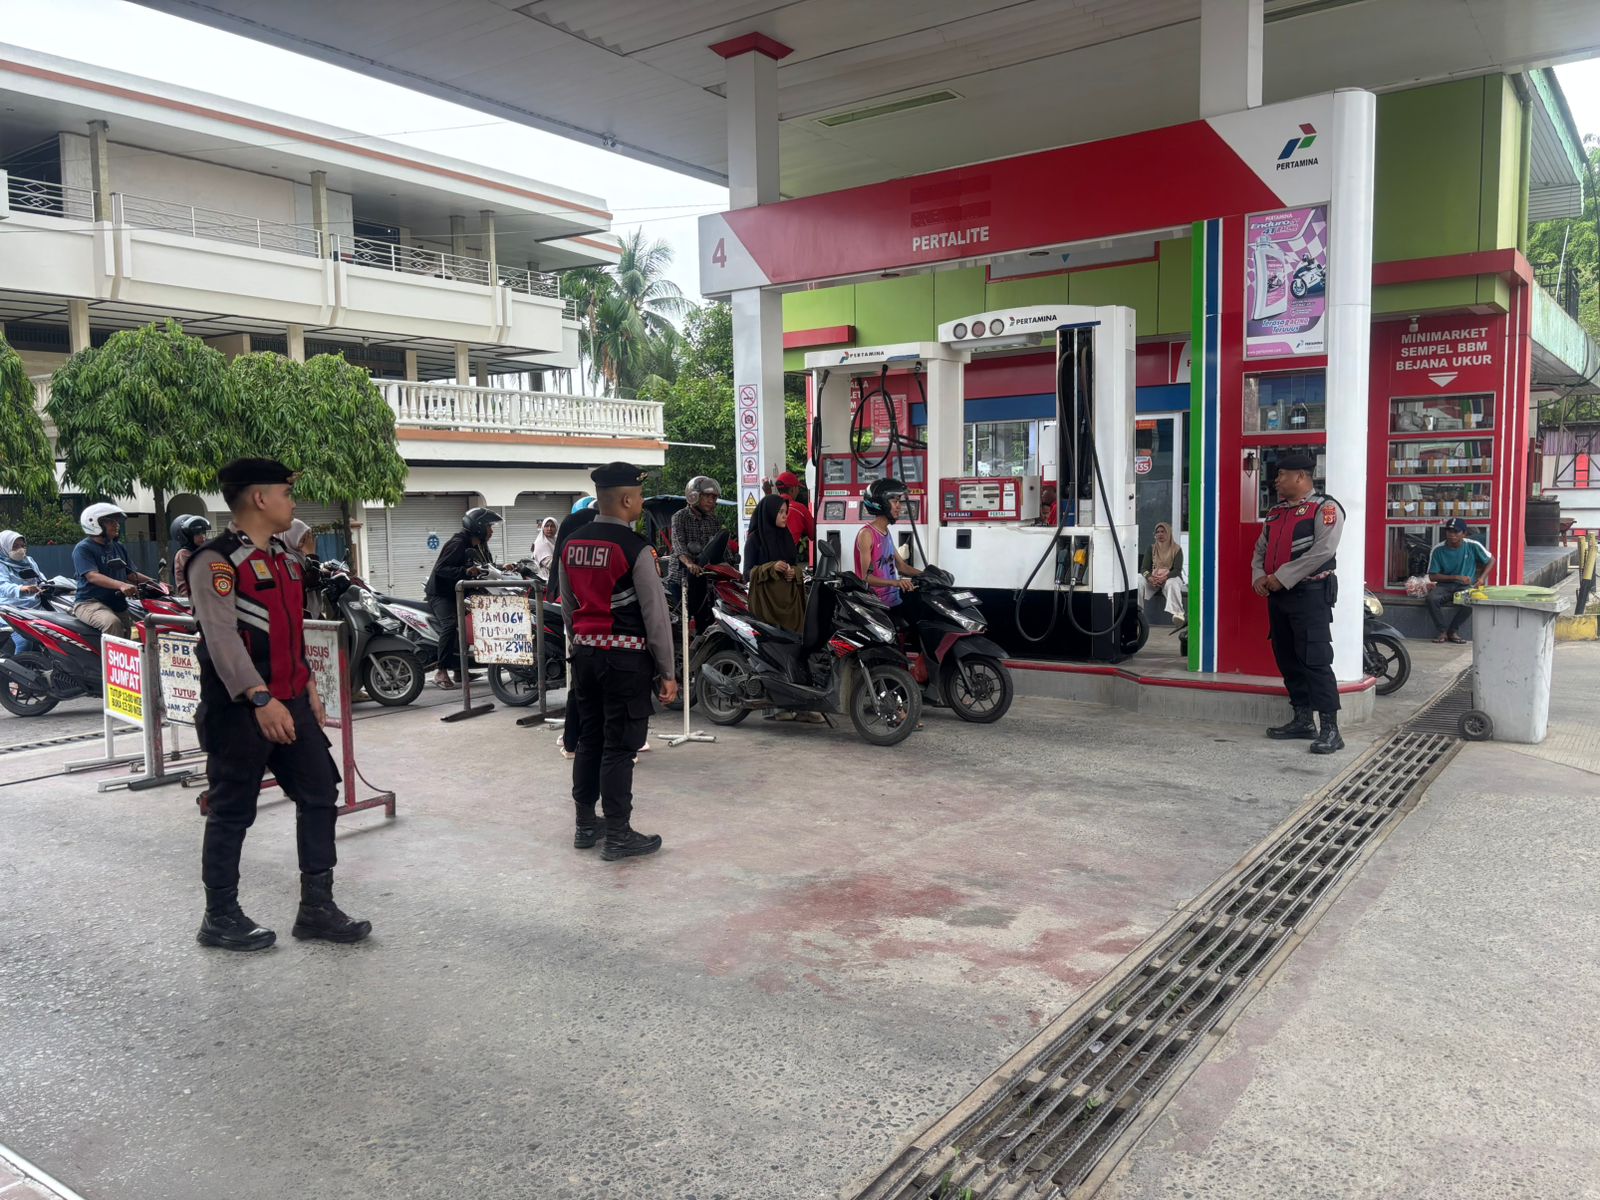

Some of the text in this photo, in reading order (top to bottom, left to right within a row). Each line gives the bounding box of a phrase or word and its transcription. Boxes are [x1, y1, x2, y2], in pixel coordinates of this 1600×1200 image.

[1276, 157, 1319, 170] PERTAMINA
[912, 226, 990, 252] PERTALITE
[712, 237, 727, 268] 4
[1016, 314, 1058, 325] PERTAMINA
[1401, 327, 1488, 344] MINIMARKET
[1401, 341, 1488, 358] SEMPEL BBM
[1396, 354, 1492, 371] BEJANA UKUR
[567, 546, 609, 567] POLISI
[480, 611, 500, 623] JAM
[304, 644, 330, 658] USUS
[108, 649, 140, 673] SHOLAT
[171, 656, 192, 667] BUKA
[161, 669, 175, 678] JAM
[172, 687, 197, 698] TUTUP
[167, 702, 180, 711] JAM
